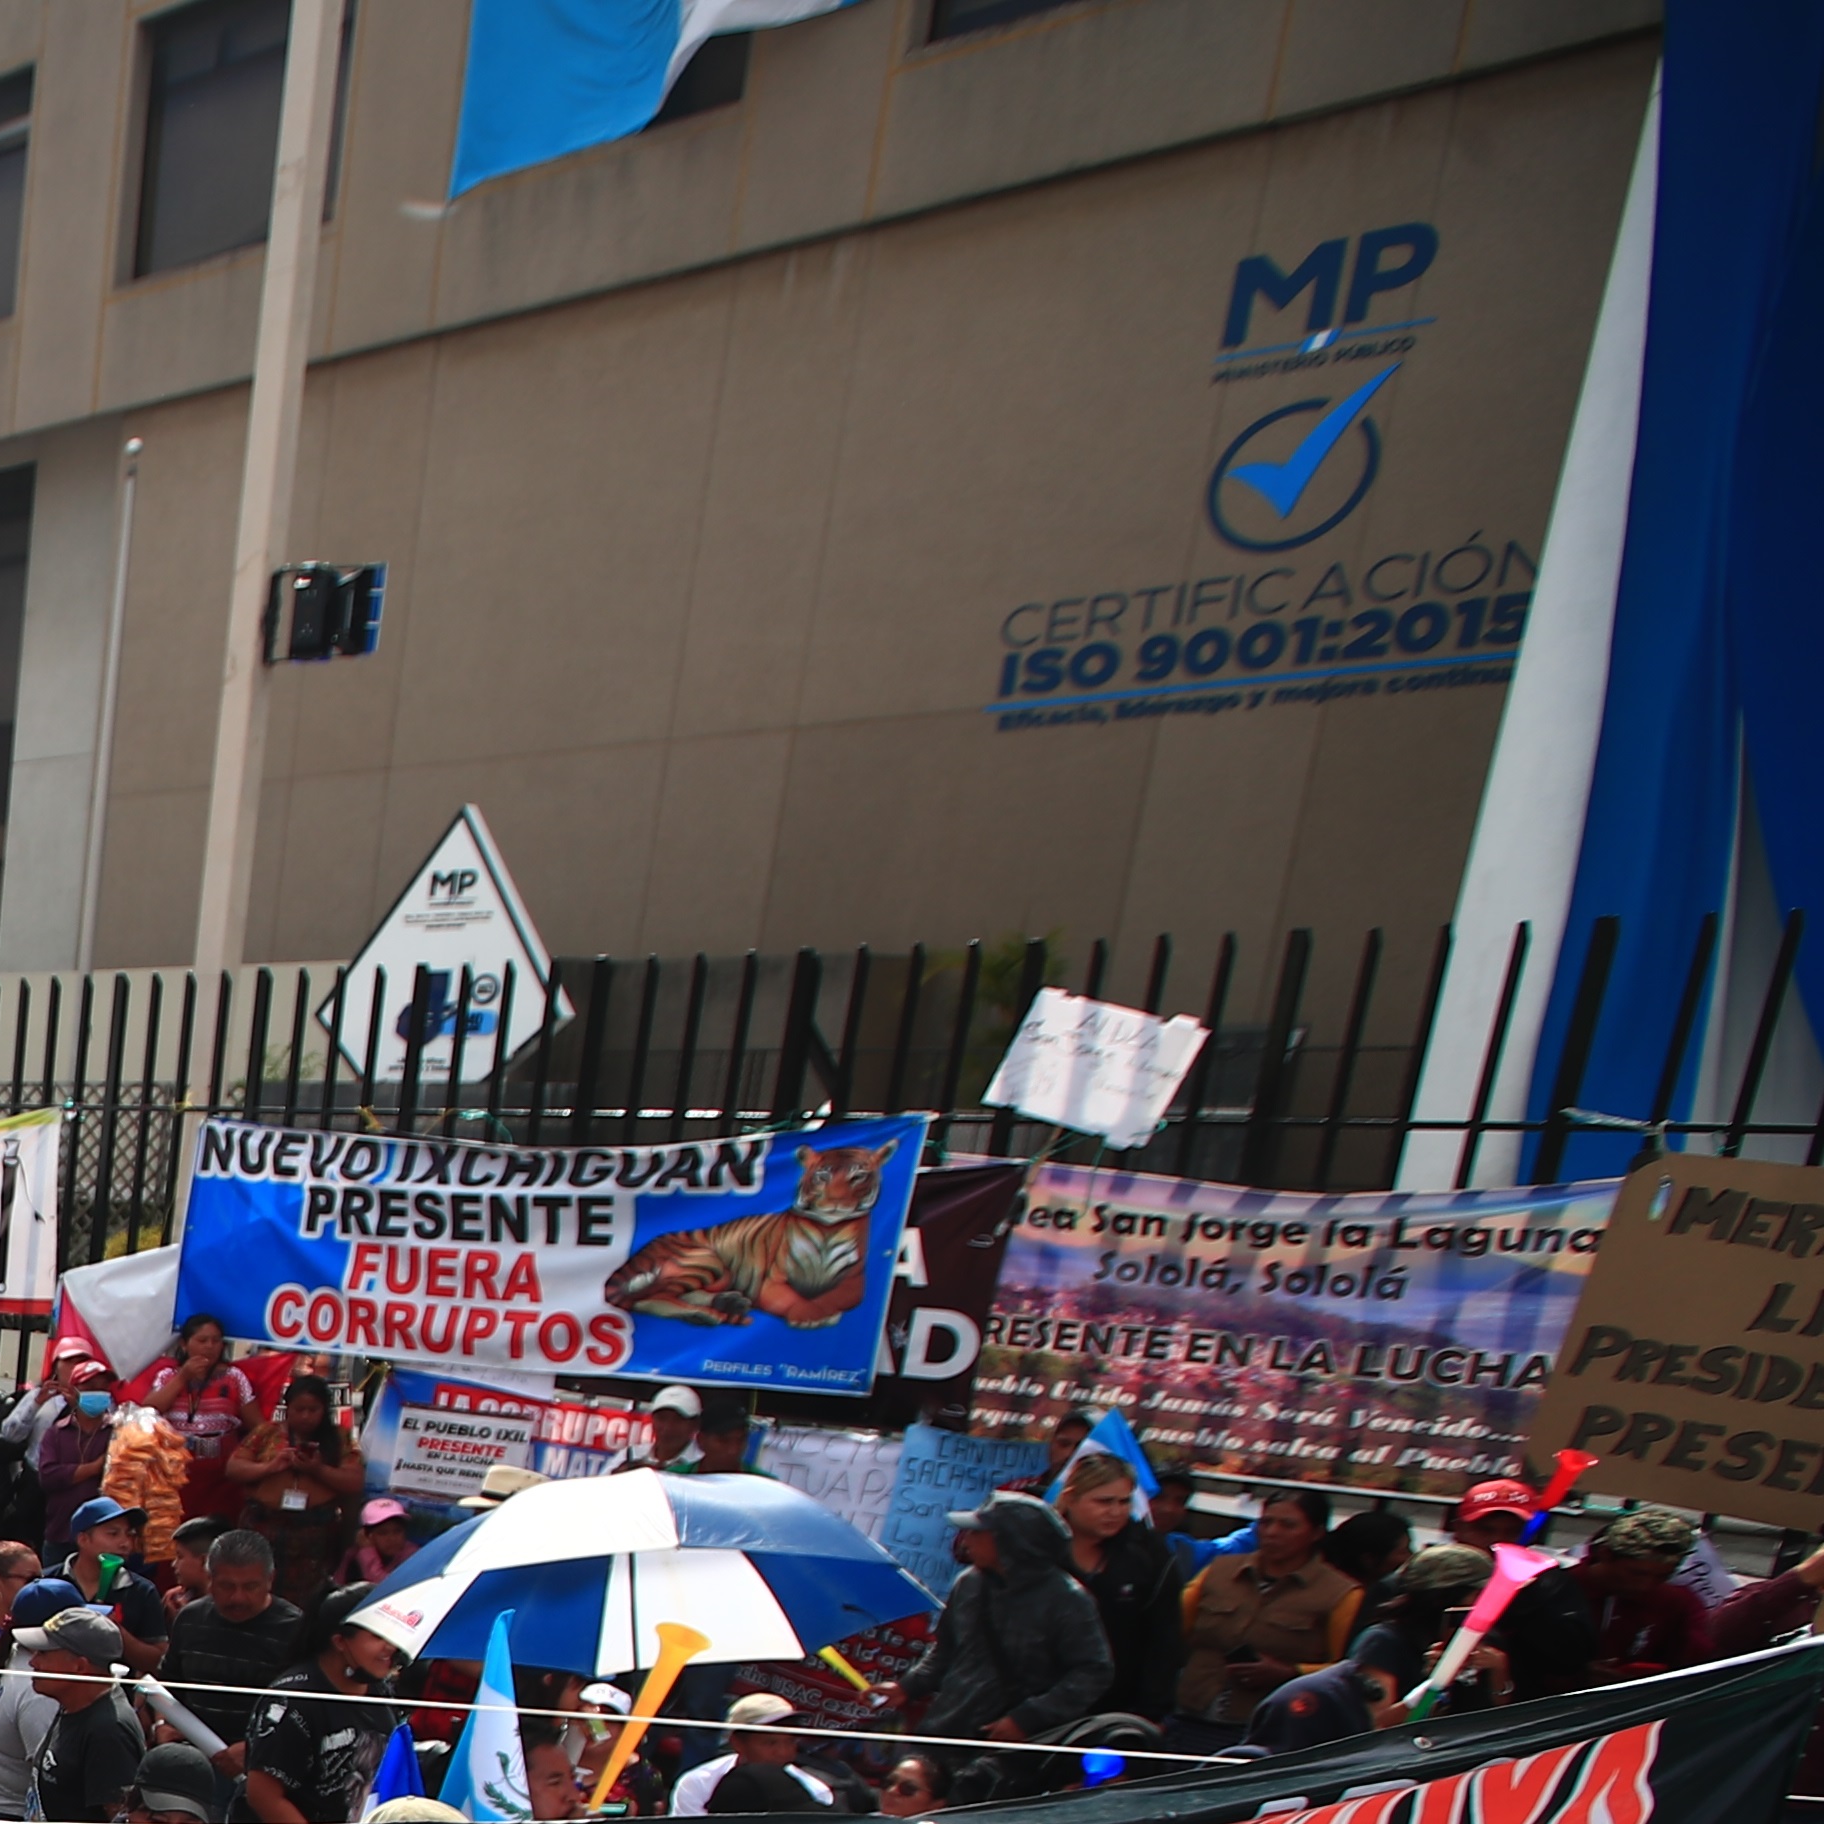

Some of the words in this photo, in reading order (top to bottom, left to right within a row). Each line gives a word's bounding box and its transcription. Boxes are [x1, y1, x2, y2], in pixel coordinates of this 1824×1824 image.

[1221, 223, 1440, 348] MP
[1000, 529, 1539, 649] CERTIFICACIÓN
[998, 640, 1120, 698] ISO
[1137, 591, 1533, 682] 9001:2015
[430, 869, 479, 896] MP
[199, 1120, 394, 1183] NUEVO
[392, 1136, 769, 1194] IXCHIGUAN
[302, 1187, 616, 1247] PRESENTE
[1090, 1202, 1168, 1239] San
[1180, 1211, 1309, 1252] Jorge
[1389, 1215, 1608, 1259] Laguna
[1666, 1186, 1824, 1258] MER
[349, 1243, 542, 1303] FUERA
[1094, 1252, 1245, 1296] Sololá,
[1259, 1260, 1407, 1303] Sololá
[266, 1290, 628, 1369] CORRUPTOS
[984, 1314, 1176, 1364] RESENTE
[1184, 1331, 1252, 1369] EN
[1267, 1337, 1338, 1376] LA
[1354, 1344, 1548, 1392] LUCHA
[973, 1375, 1044, 1397] ueblo
[402, 1417, 422, 1430] EL
[424, 1420, 492, 1440] PUEBLO
[496, 1428, 528, 1444] IXIL
[417, 1437, 506, 1458] PRESENTE
[970, 1408, 1034, 1430] rque
[460, 1467, 485, 1479] RENU
